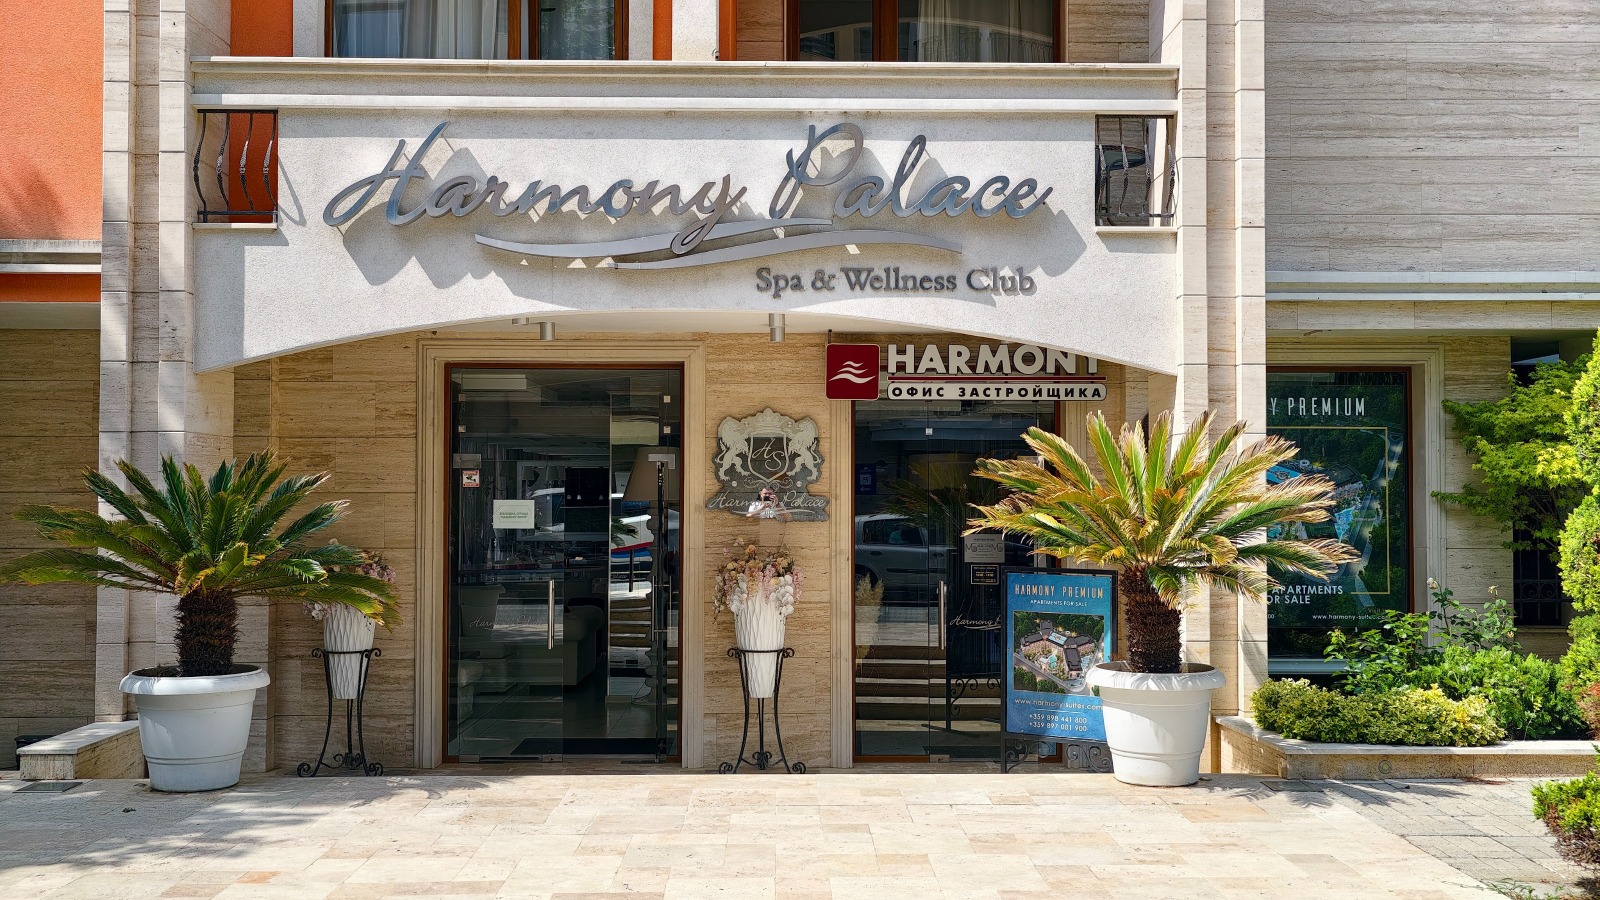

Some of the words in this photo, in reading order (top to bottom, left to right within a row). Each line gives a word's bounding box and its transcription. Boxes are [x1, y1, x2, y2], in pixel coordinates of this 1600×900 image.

[323, 121, 748, 257] Harmony
[768, 122, 1053, 221] Palace
[756, 267, 804, 299] Spa
[811, 268, 836, 291] &
[841, 266, 958, 292] Wellness
[966, 266, 1036, 296] Club
[891, 385, 945, 399] ОФИС
[958, 384, 1102, 399] ЗАСТРОЙЩИКА
[1288, 397, 1366, 416] PREMIUM
[1014, 584, 1055, 597] HARMONY
[1062, 586, 1104, 599] PREMIUM
[1272, 585, 1343, 595] APARTMENTS
[1284, 595, 1311, 604] SALE
[1046, 714, 1058, 722] 898
